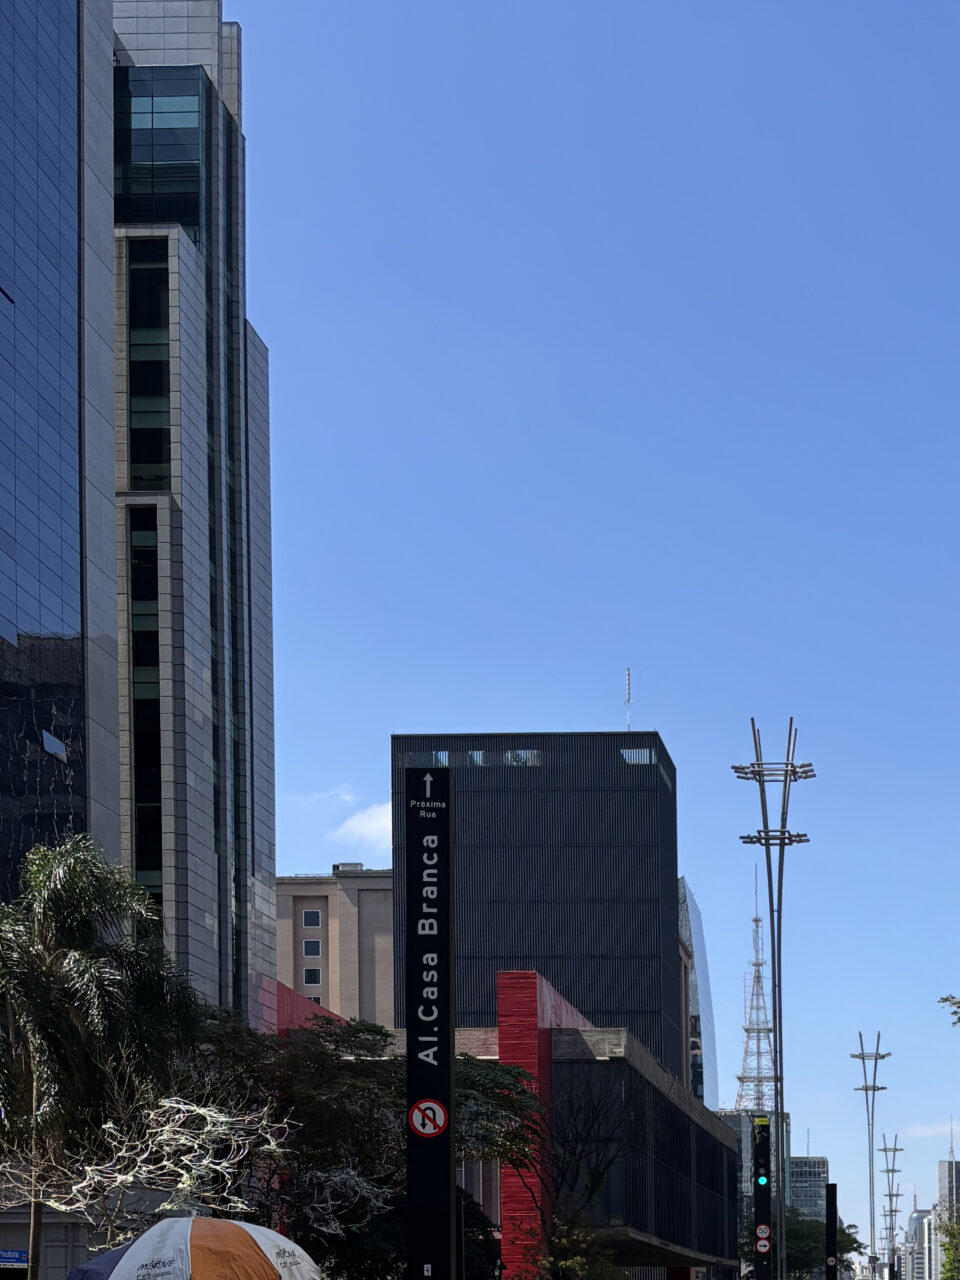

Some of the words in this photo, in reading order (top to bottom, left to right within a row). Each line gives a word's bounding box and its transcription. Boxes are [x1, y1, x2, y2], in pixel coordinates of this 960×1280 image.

[410, 800, 446, 808] Próxima
[419, 810, 437, 818] Rua
[417, 835, 439, 935] Branca
